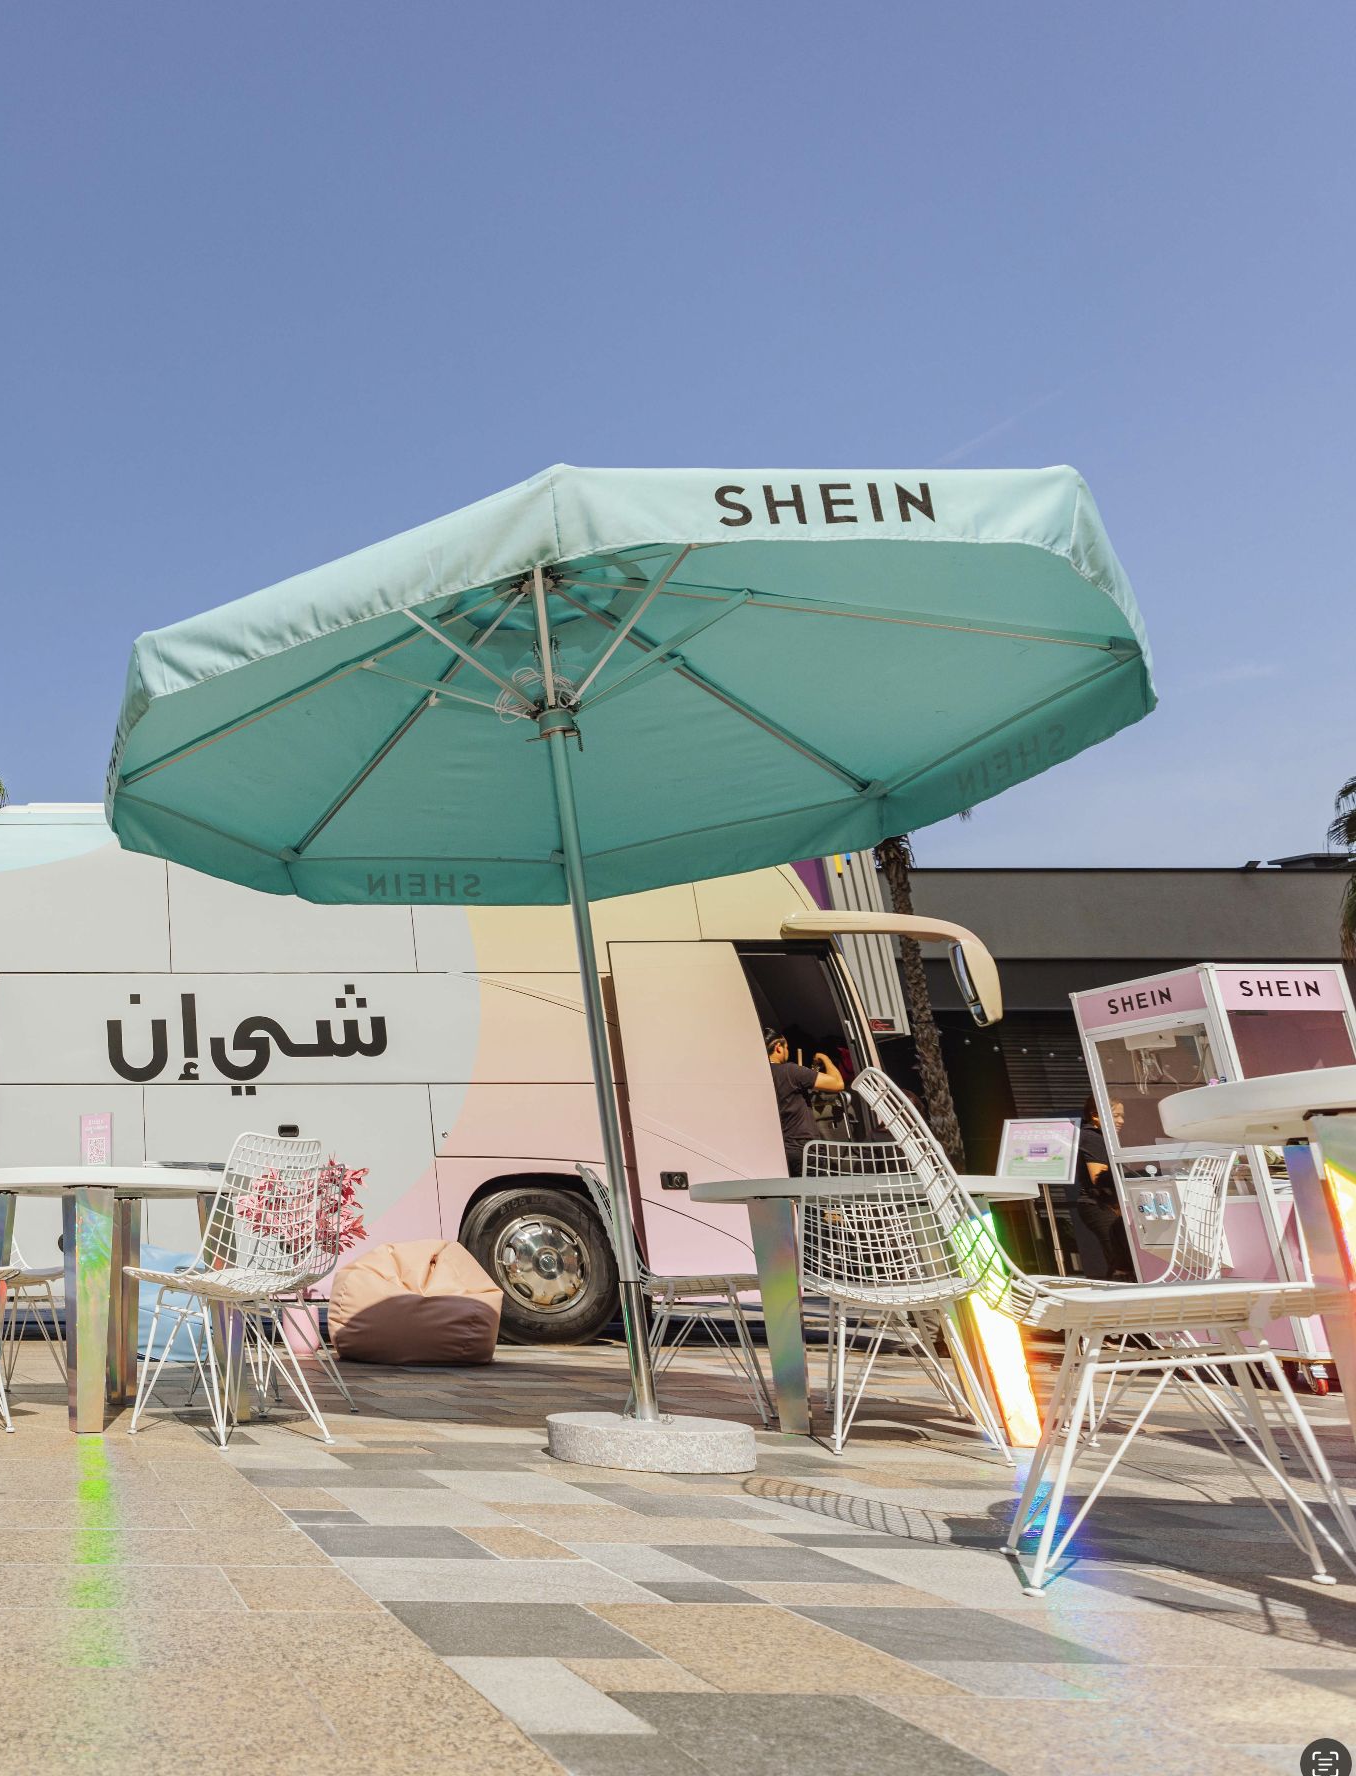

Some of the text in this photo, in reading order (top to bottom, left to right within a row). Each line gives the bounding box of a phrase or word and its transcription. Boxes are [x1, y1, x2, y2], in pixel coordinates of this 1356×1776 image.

[714, 482, 936, 527] SHEIN
[1107, 987, 1173, 1015] SHEIN
[1239, 980, 1321, 997] SHEIN
